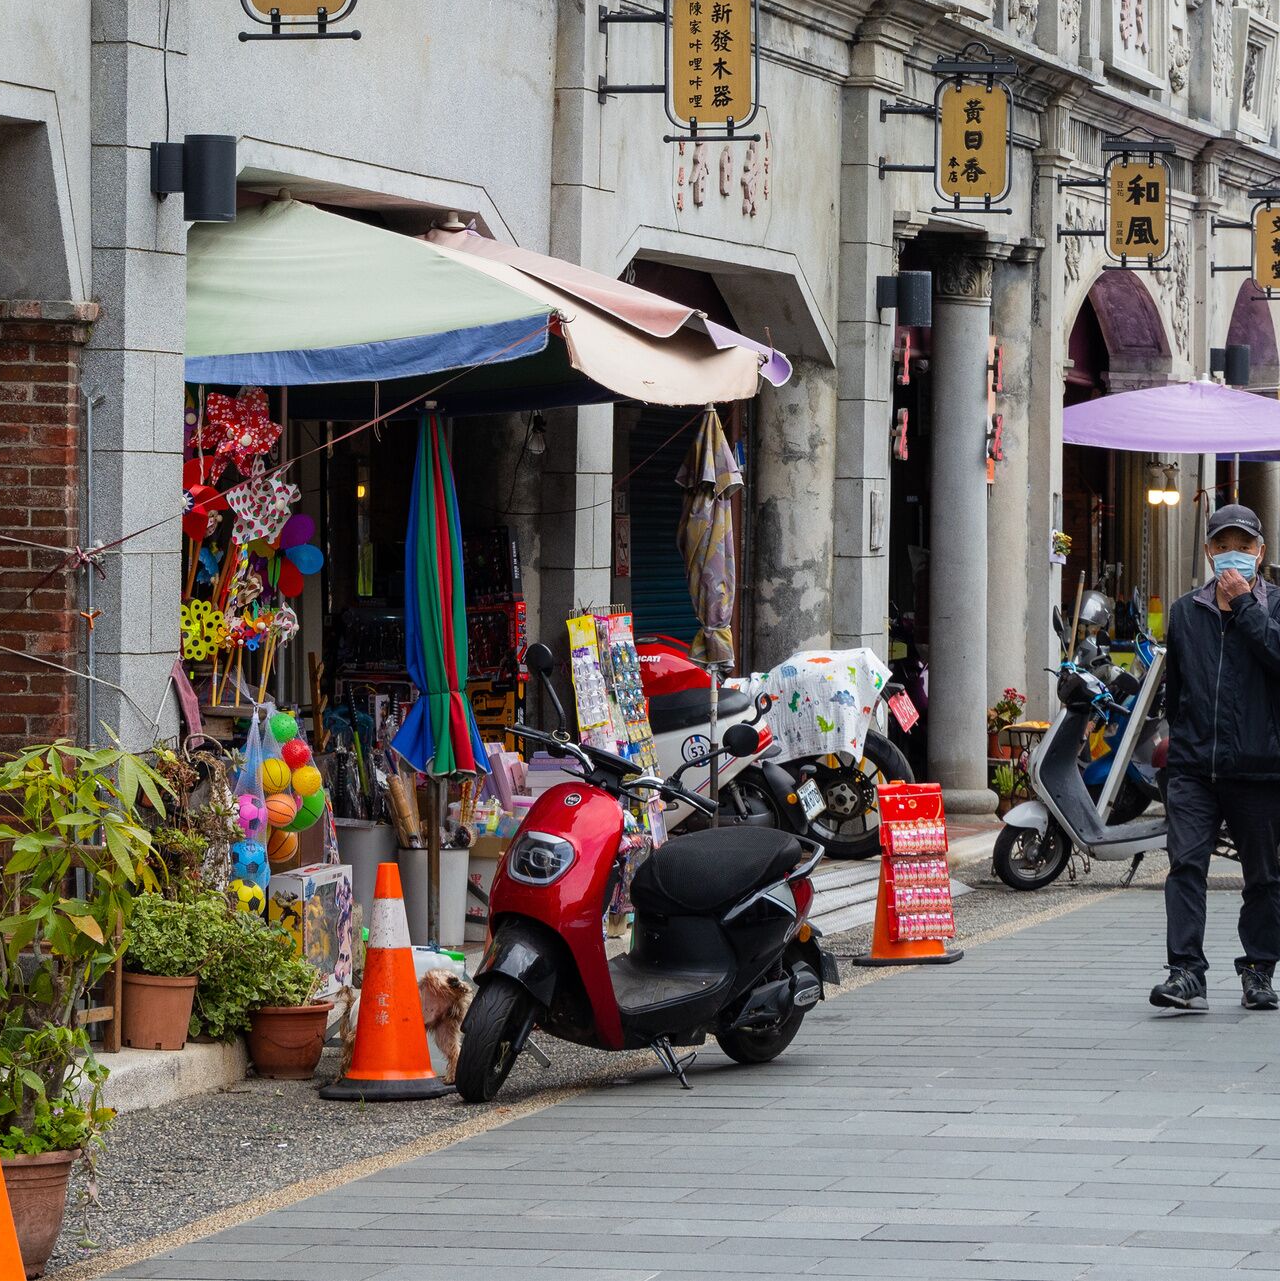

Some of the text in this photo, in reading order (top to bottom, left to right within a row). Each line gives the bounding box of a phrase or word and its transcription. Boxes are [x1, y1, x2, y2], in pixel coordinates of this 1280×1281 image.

[710, 2, 734, 108] 新發木器
[948, 156, 960, 183] 本店
[961, 99, 987, 183] 黃日香
[1125, 173, 1161, 246] 和風
[690, 745, 706, 758] 53
